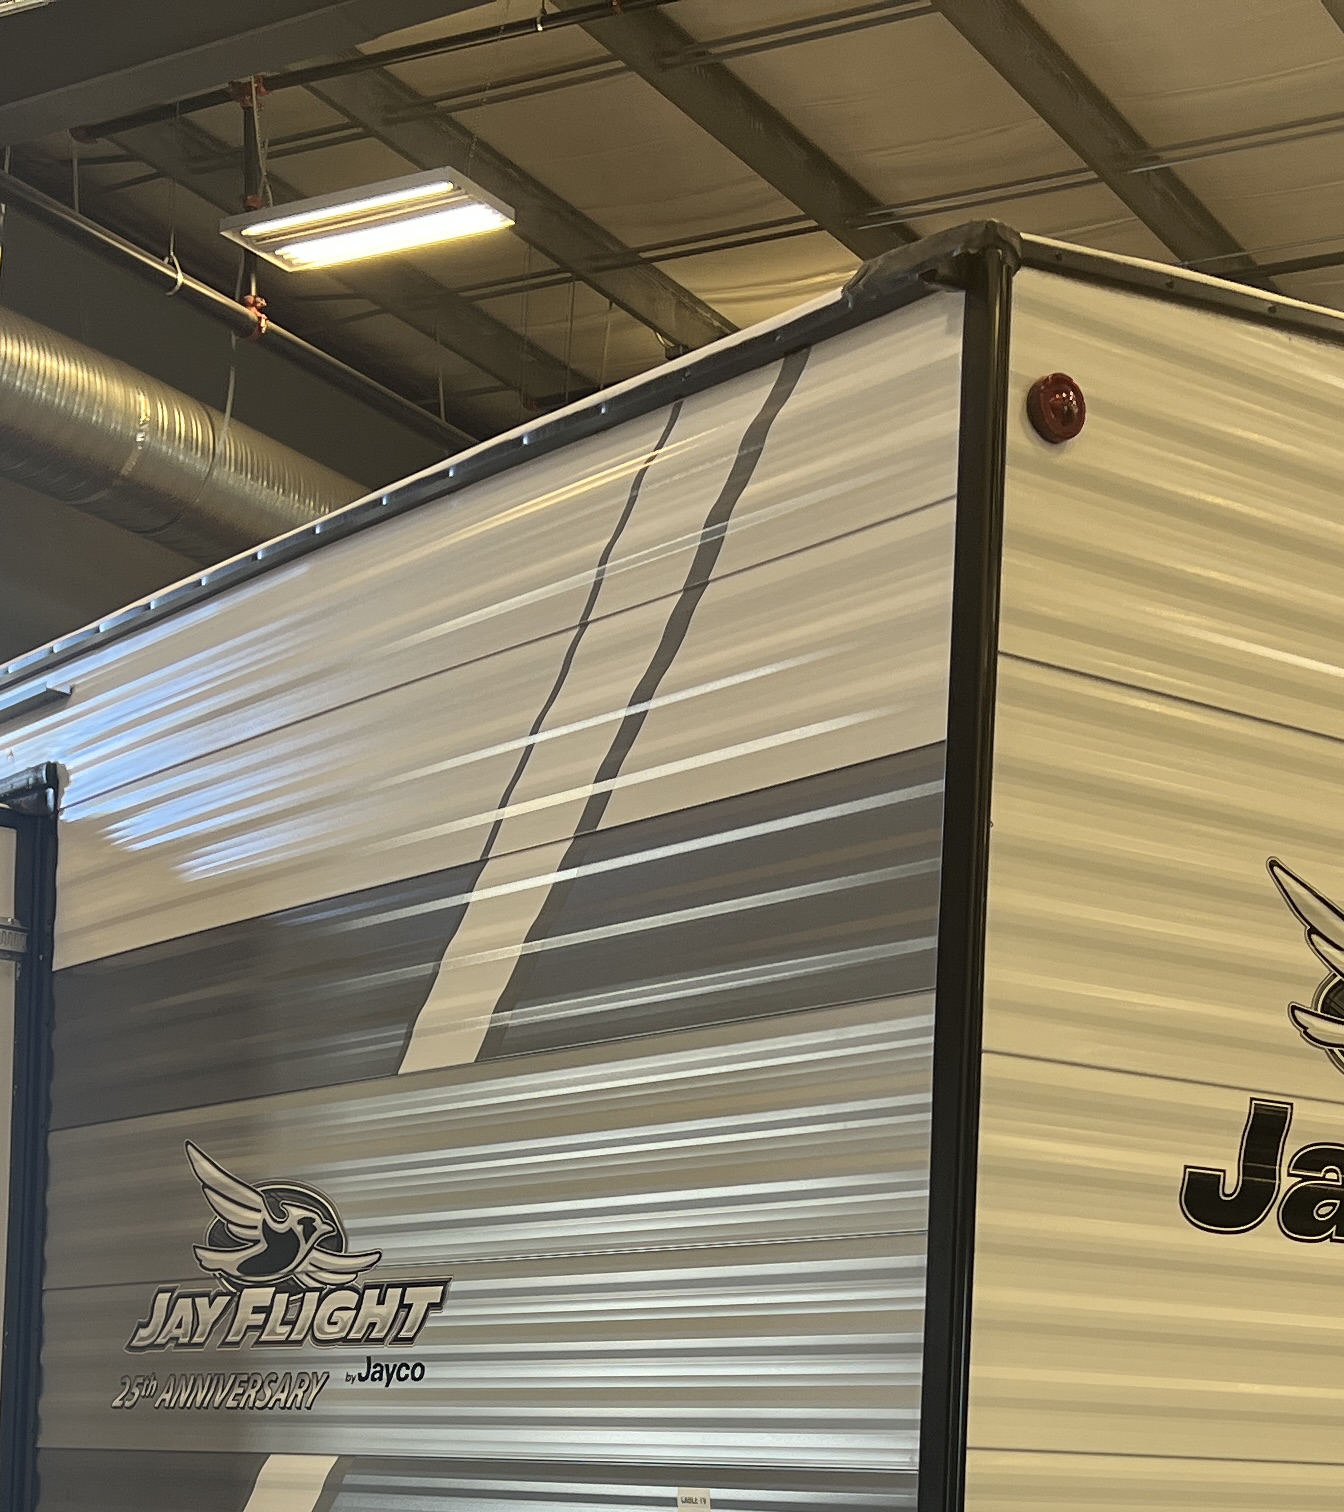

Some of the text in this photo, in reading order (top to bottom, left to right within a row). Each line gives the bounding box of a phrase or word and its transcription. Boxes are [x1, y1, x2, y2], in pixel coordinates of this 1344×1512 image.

[124, 1276, 453, 1352] JAY FLIGHT
[111, 1371, 329, 1410] 25th ANNIVERSARY
[346, 1357, 425, 1387] by Jayco
